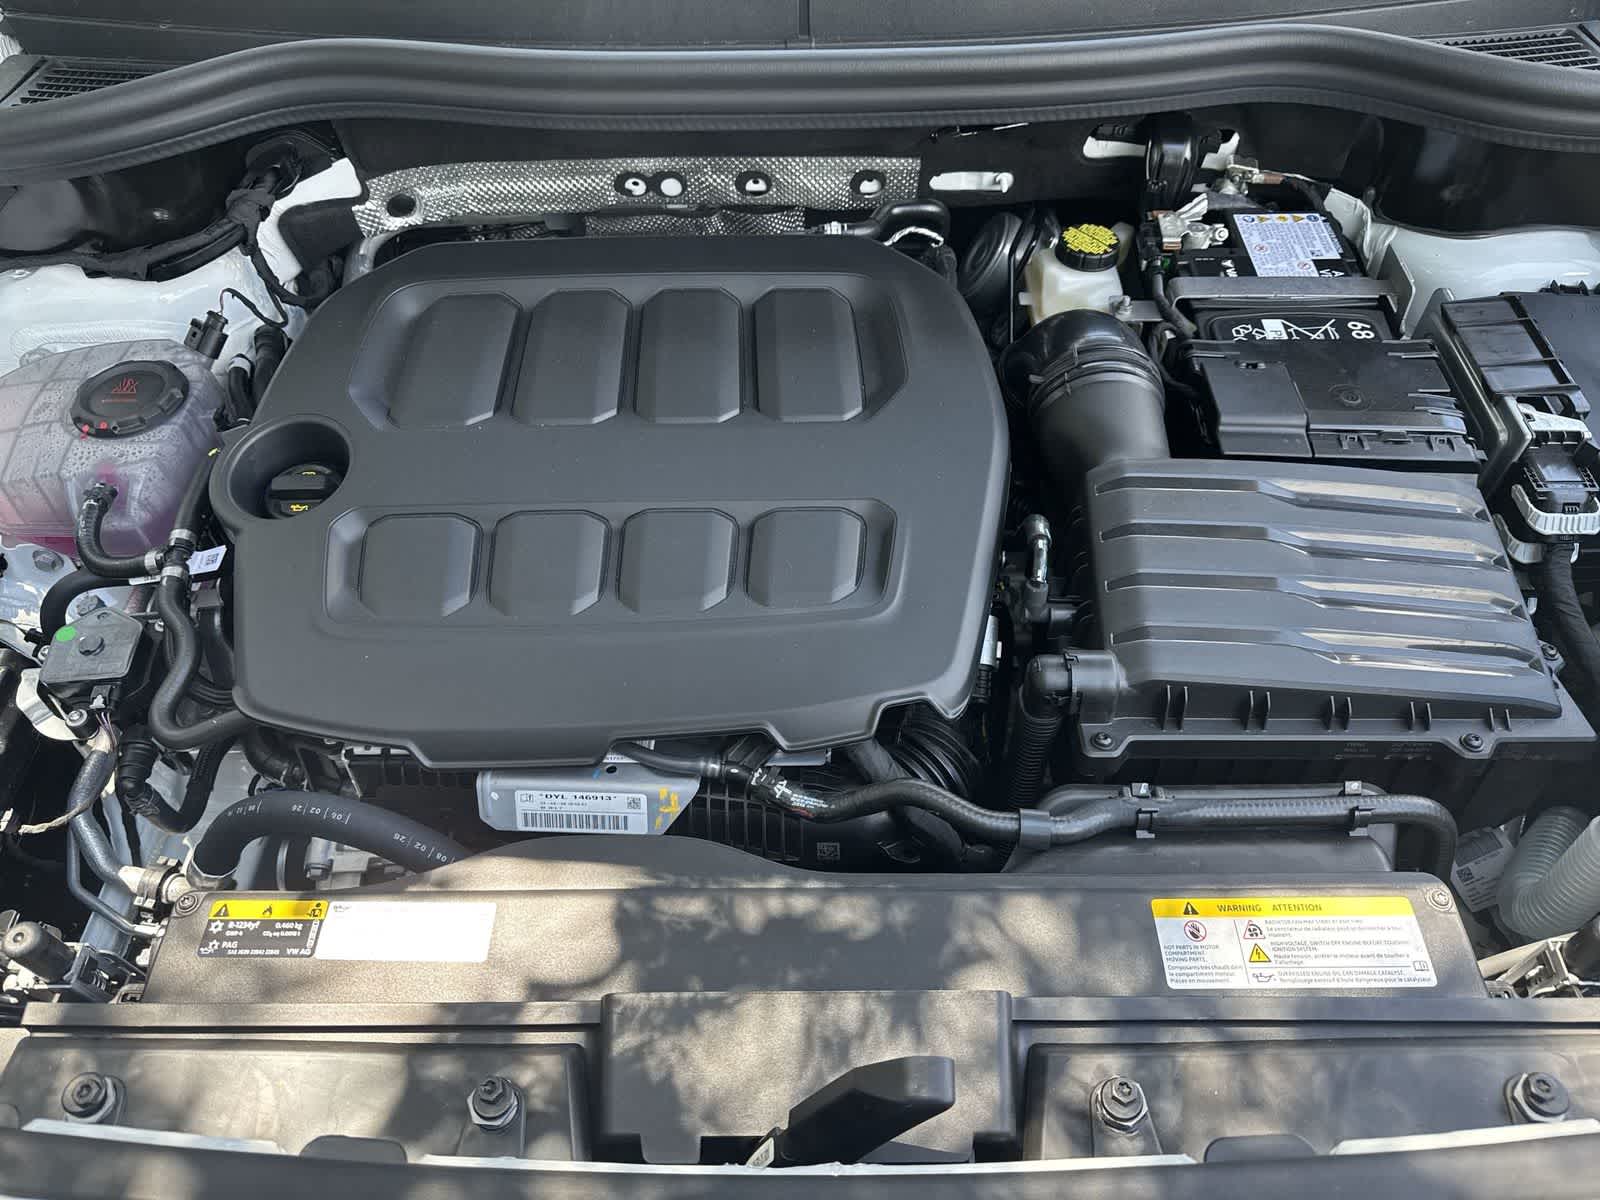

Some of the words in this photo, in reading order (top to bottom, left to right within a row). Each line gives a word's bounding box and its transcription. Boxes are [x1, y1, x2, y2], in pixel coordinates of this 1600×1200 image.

[1347, 321, 1375, 339] 68
[1217, 903, 1262, 913] WARNING
[1272, 903, 1322, 913] ATTENTION
[222, 941, 239, 949] PAG
